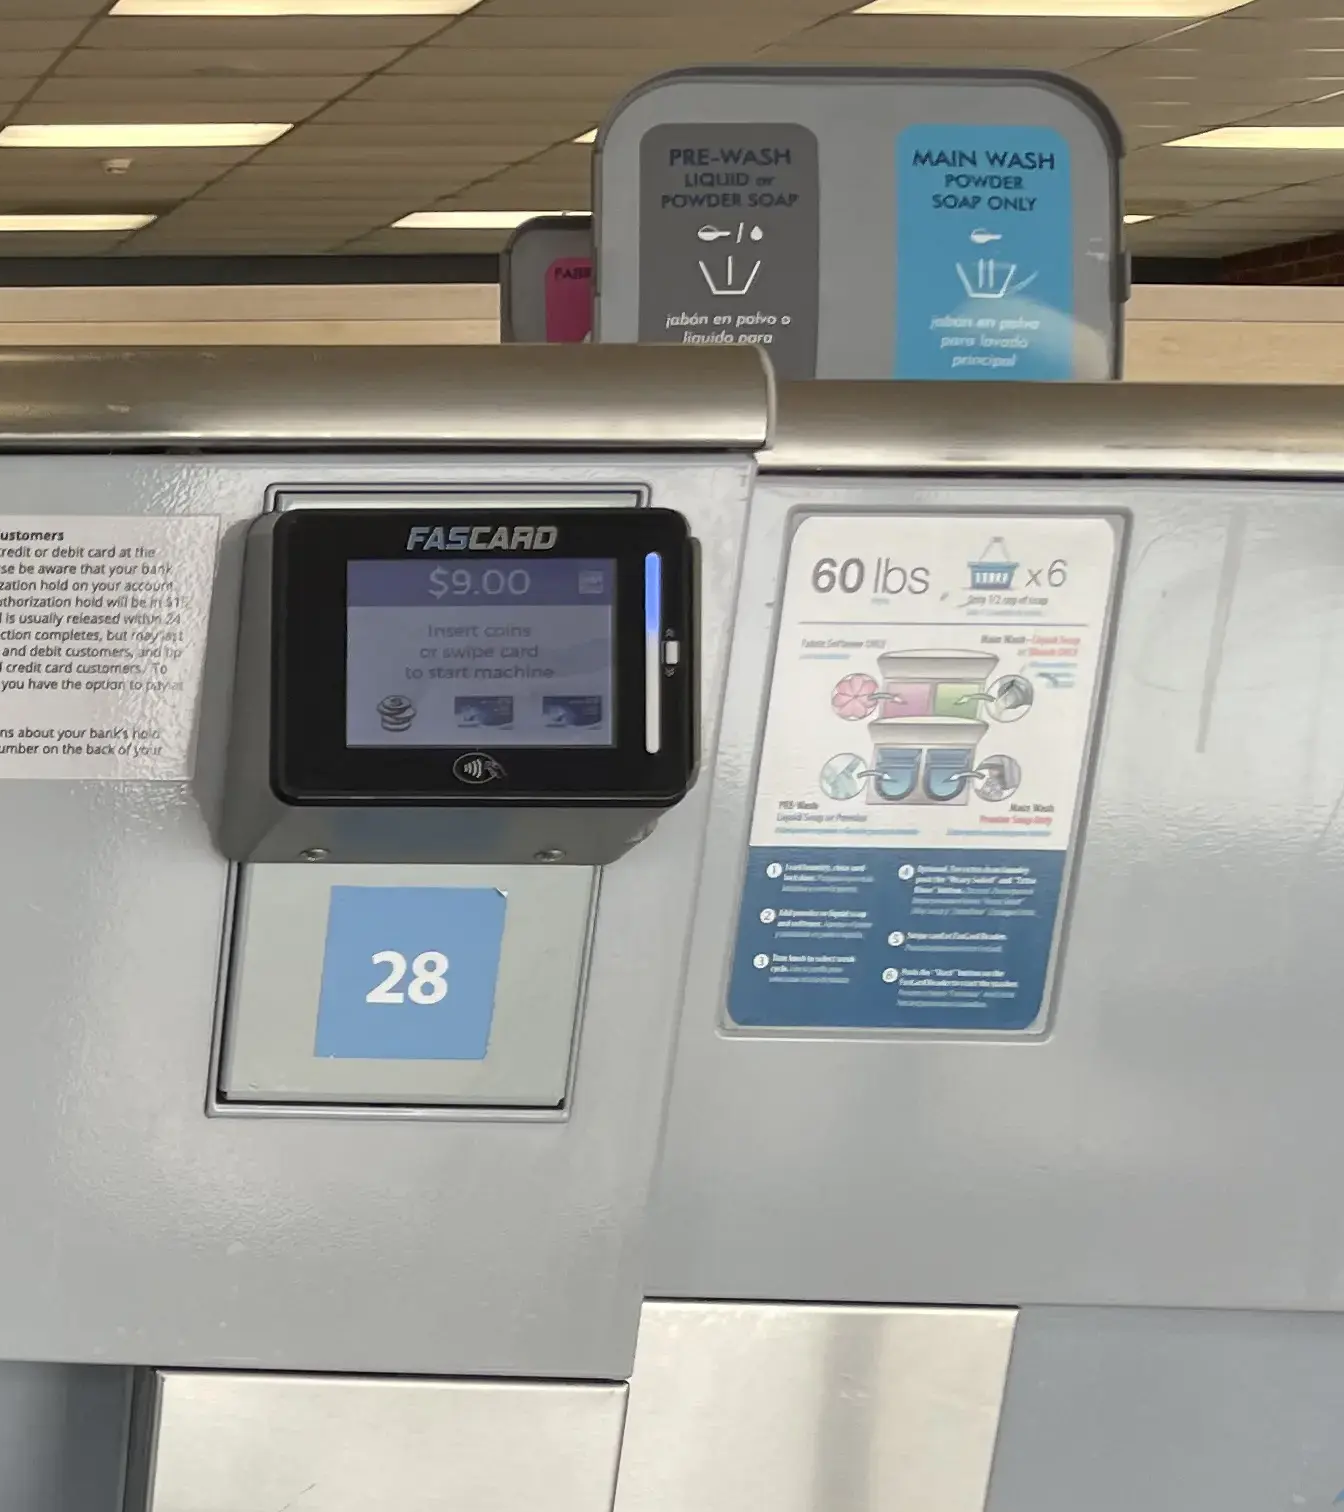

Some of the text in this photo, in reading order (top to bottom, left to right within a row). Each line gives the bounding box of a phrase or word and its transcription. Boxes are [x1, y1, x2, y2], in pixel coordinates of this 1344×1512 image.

[669, 149, 791, 166] PRE-WASH
[913, 150, 1055, 170] MAIN WASH
[685, 172, 775, 188] LIQUID or
[945, 174, 1023, 189] POWDER
[662, 193, 799, 209] POWDER SOAP
[932, 194, 1038, 211] SOAP ONLY
[666, 311, 791, 329] jabón en polvo o
[406, 526, 558, 551] FASCARD
[34, 548, 48, 557] or
[52, 546, 84, 558] debit
[88, 546, 115, 558] card
[119, 547, 131, 558] at
[135, 546, 155, 558] the
[19, 562, 34, 574] be
[38, 565, 76, 574] aware
[80, 564, 105, 574] that
[109, 565, 137, 577] your
[812, 558, 865, 593] 60
[873, 558, 930, 595] lbs
[428, 564, 531, 599] $9.00
[428, 625, 531, 637] Insert coins
[2, 646, 26, 657] and
[30, 646, 61, 657] debit
[419, 645, 539, 660] or swipe card
[6, 662, 41, 673] credit
[44, 662, 72, 673] card
[405, 665, 555, 679] to start machine
[18, 728, 54, 738] about
[57, 730, 85, 741] your
[43, 745, 58, 754] on
[63, 744, 82, 754] the
[86, 744, 114, 754] back
[366, 950, 449, 1005] 28
